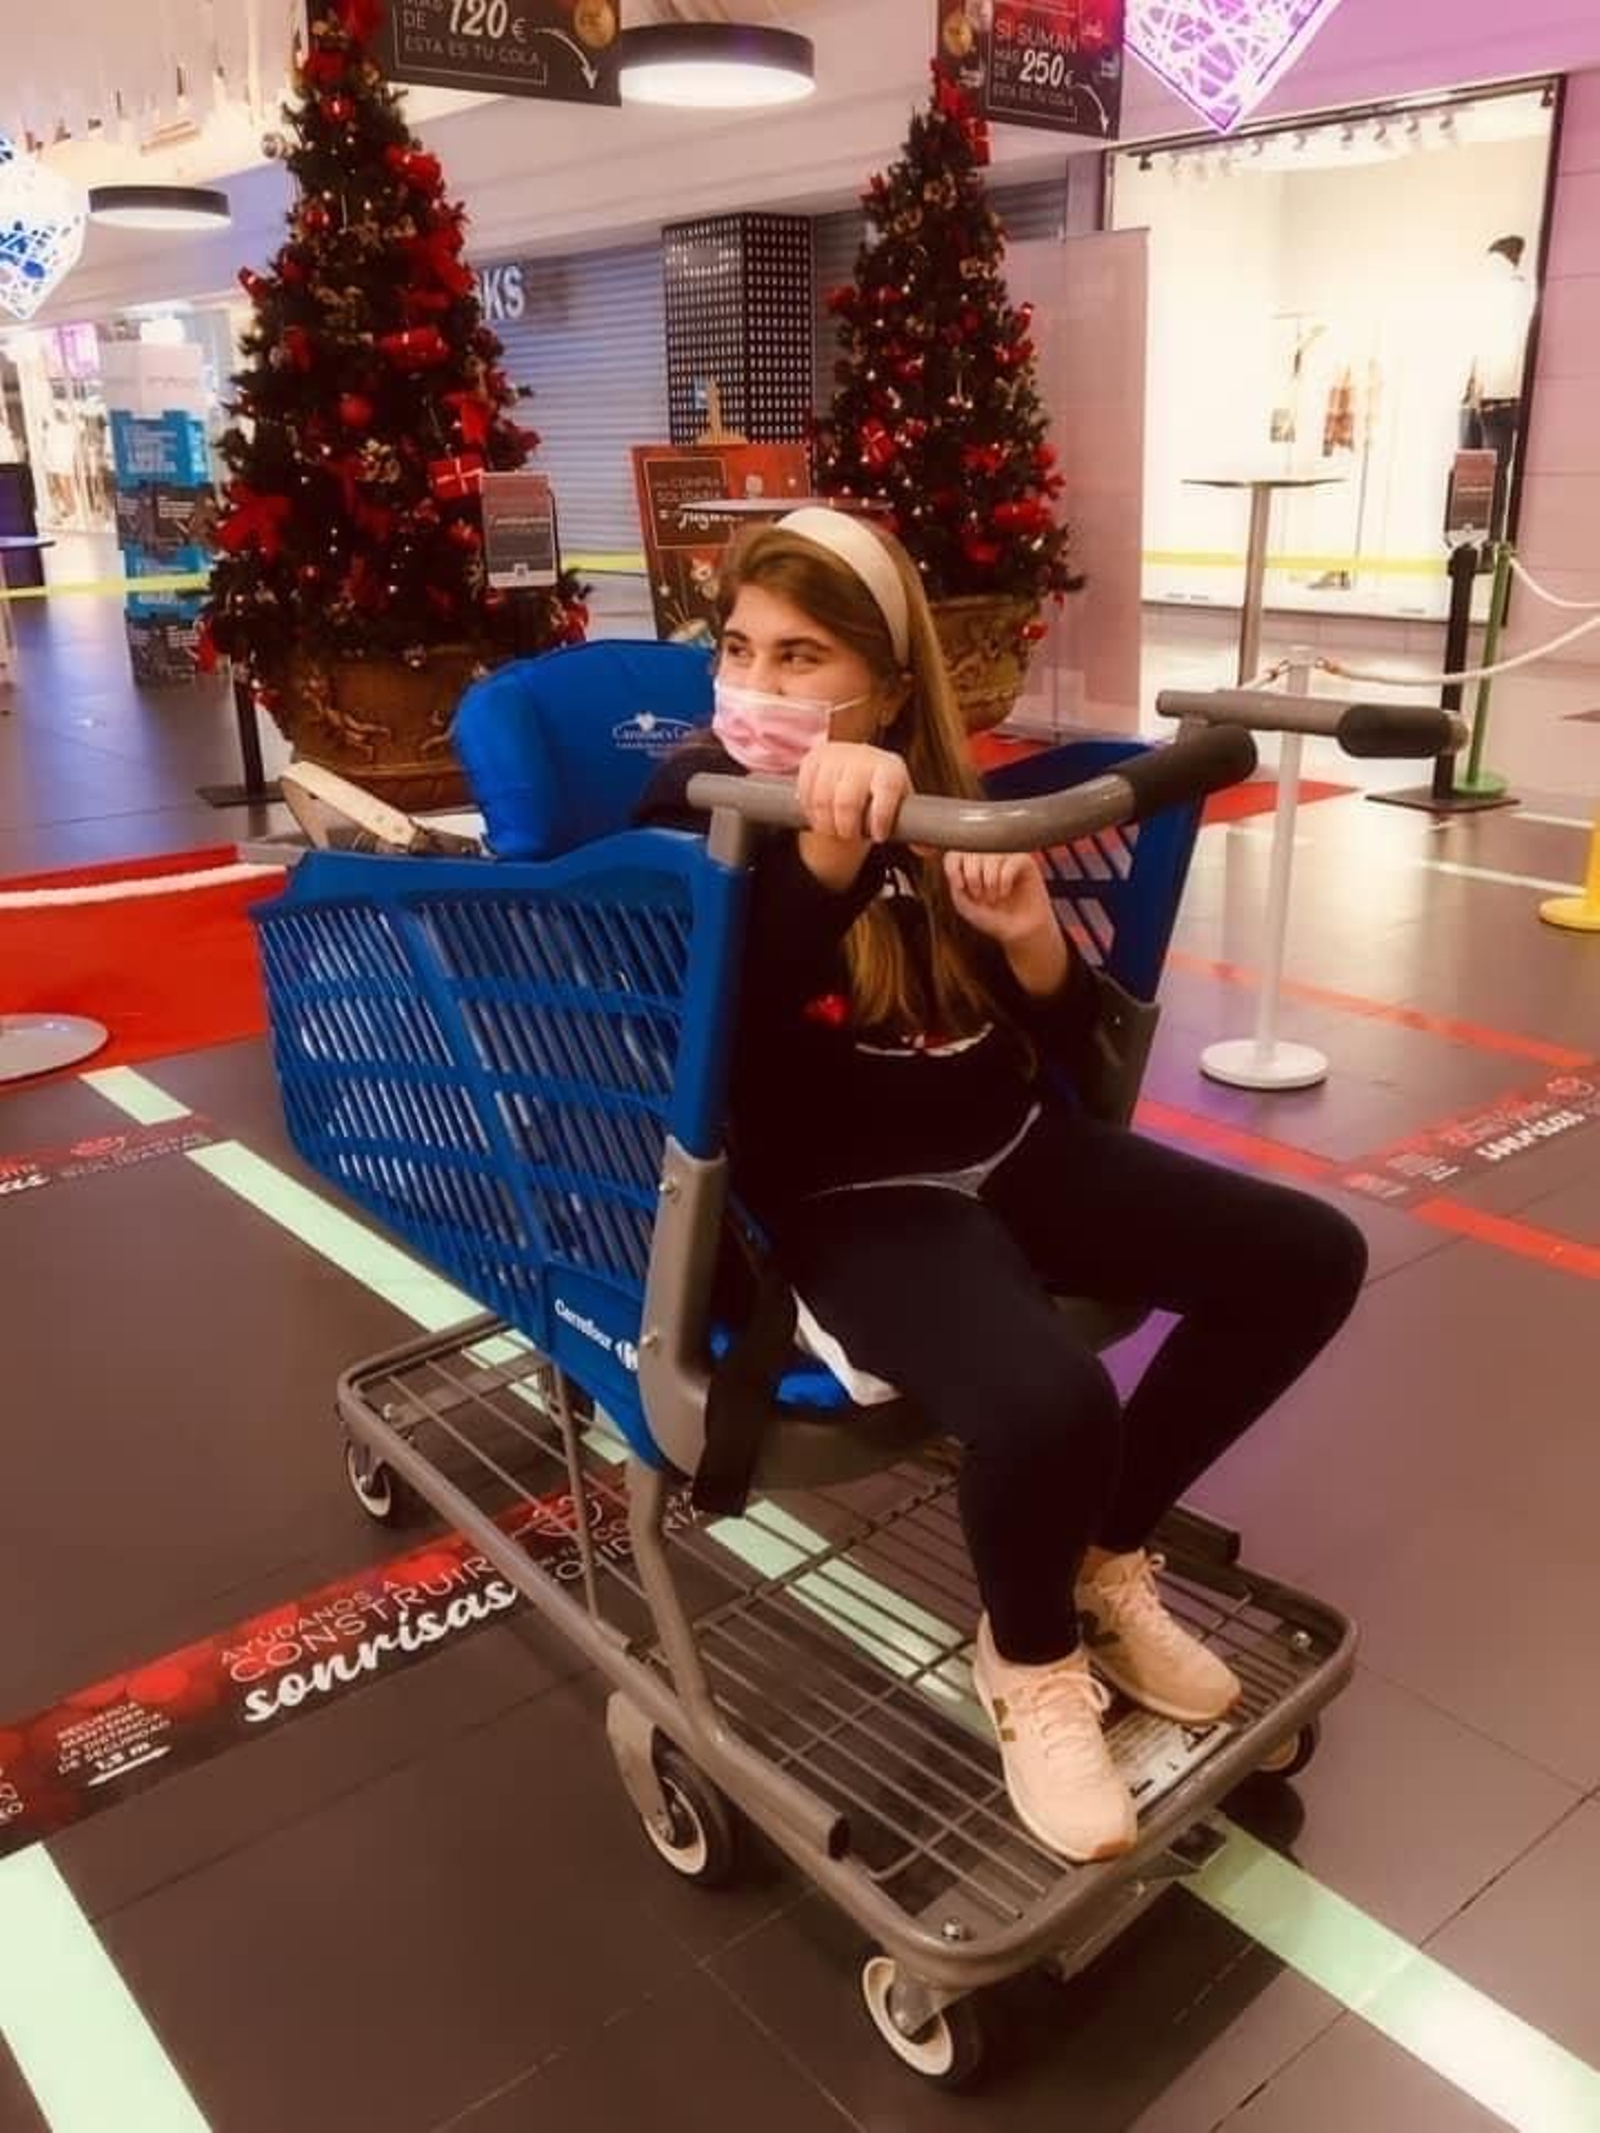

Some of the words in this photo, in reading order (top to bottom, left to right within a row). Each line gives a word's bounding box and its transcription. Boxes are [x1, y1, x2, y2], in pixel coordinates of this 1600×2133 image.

[403, 9, 427, 30] DE
[449, 0, 508, 38] 120
[511, 18, 527, 43] €
[1019, 49, 1065, 87] 250
[230, 1555, 497, 1682] CONSTRUIR
[244, 1580, 518, 1722] sonrisas
